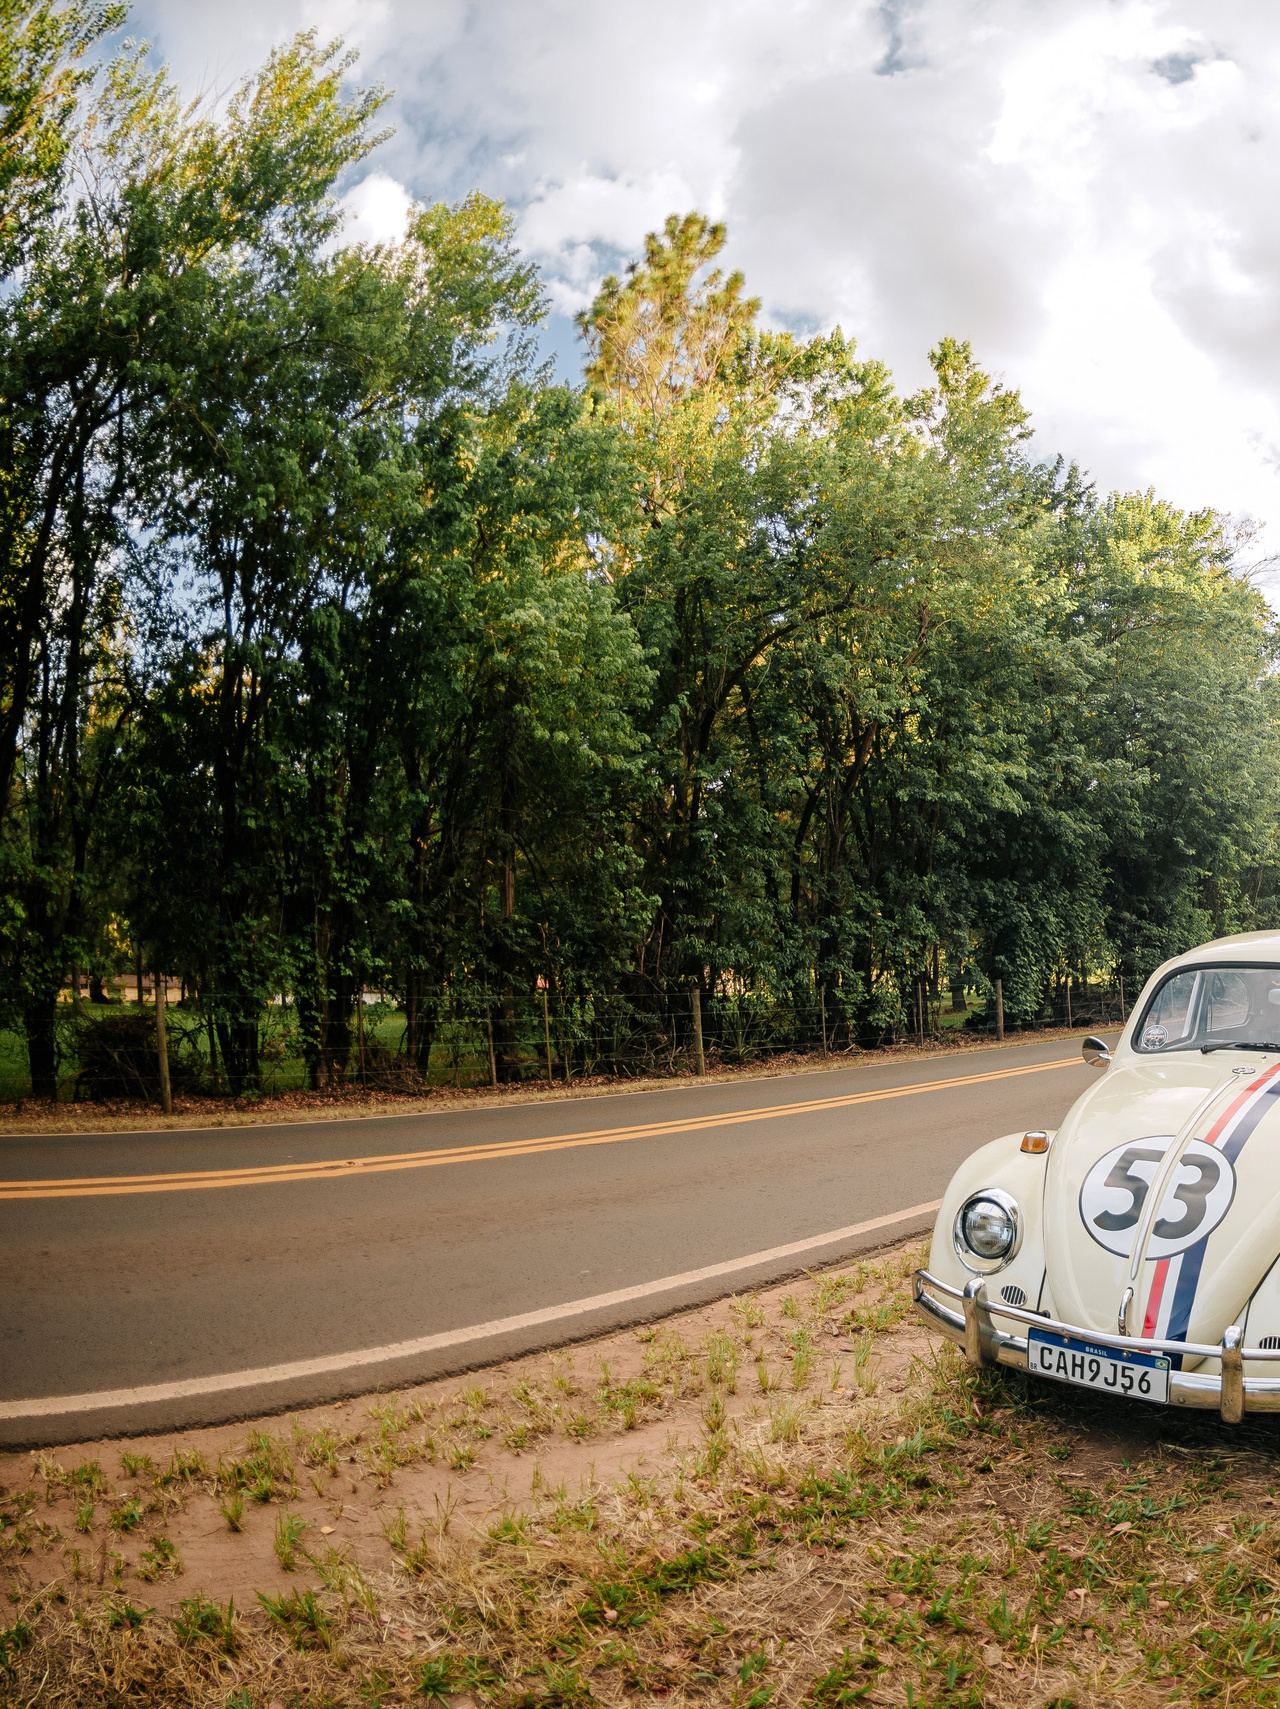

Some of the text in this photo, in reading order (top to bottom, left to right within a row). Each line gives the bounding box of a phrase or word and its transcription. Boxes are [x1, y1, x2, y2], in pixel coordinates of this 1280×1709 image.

[1093, 1147, 1221, 1240] 53
[1030, 1361, 1038, 1370] BR
[1085, 1346, 1108, 1357] BRASIL
[1040, 1346, 1151, 1394] CAH9J56
